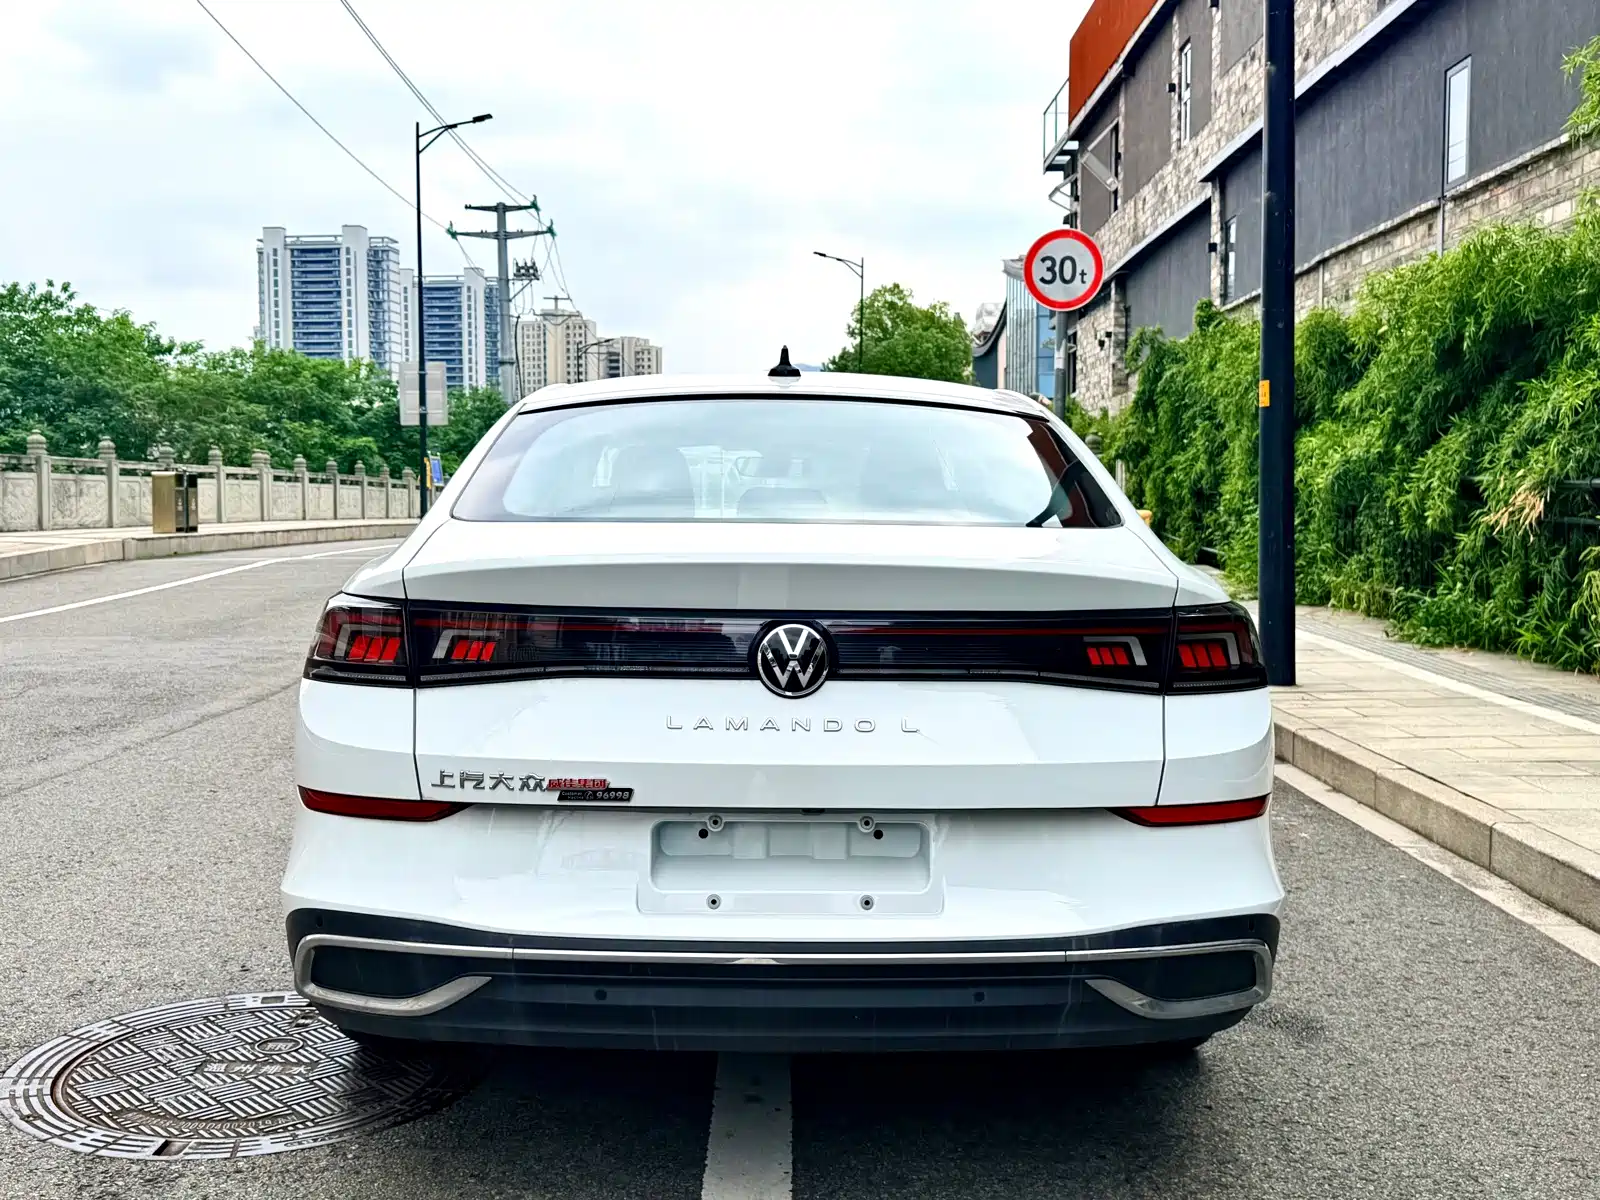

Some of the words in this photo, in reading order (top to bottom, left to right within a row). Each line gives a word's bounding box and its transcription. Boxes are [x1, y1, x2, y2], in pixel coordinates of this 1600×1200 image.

[666, 715, 876, 733] LAMANDO
[900, 716, 920, 733] L
[431, 768, 546, 793] 上汽大众
[547, 778, 607, 789] 威佳集团
[596, 791, 630, 800] 96998
